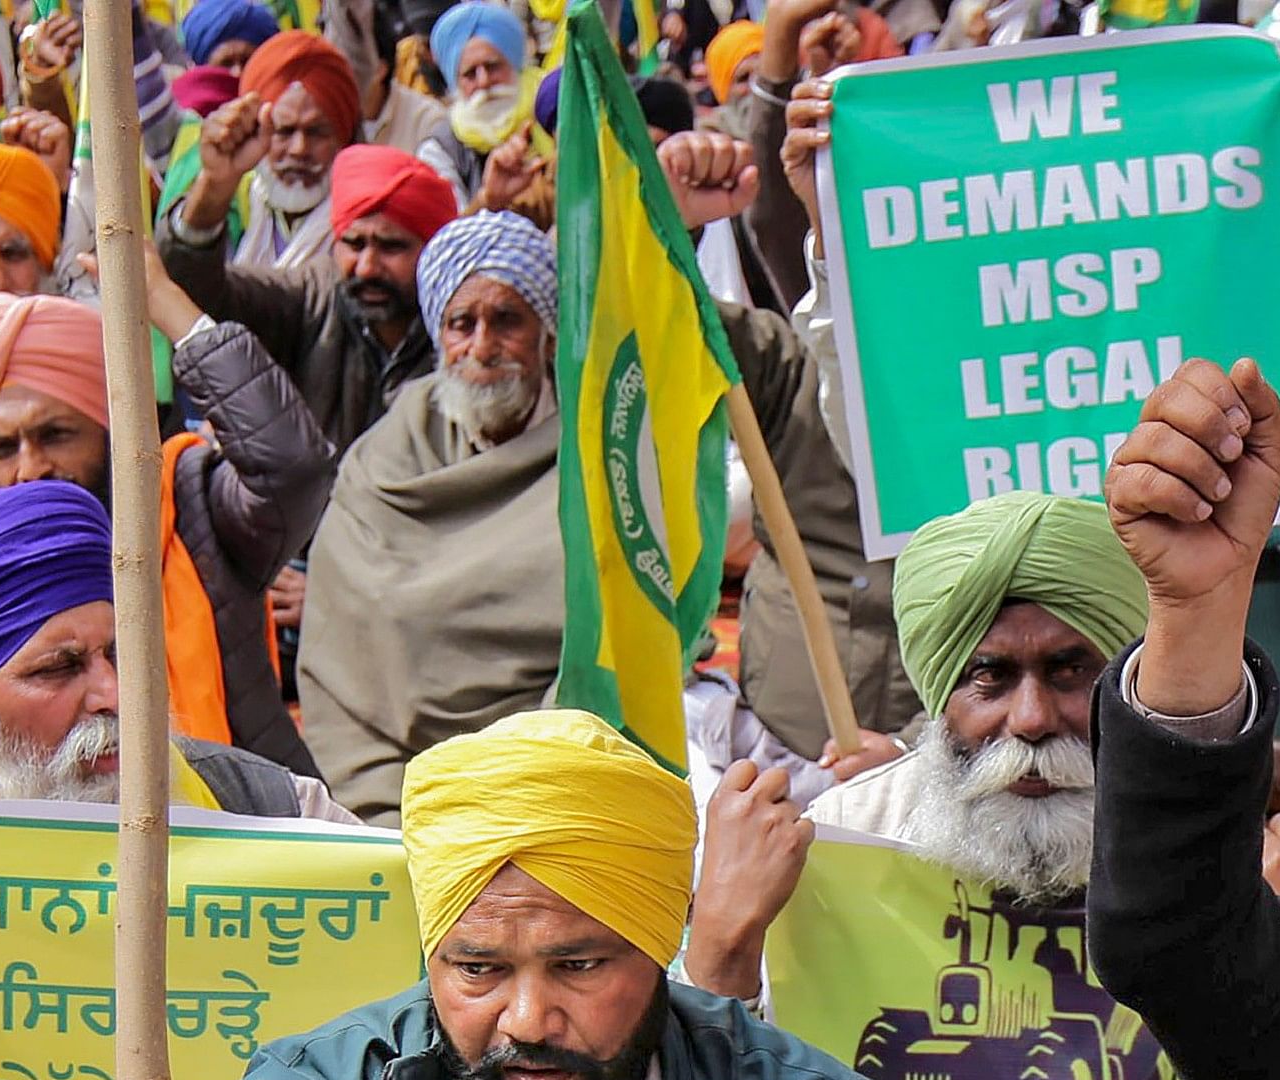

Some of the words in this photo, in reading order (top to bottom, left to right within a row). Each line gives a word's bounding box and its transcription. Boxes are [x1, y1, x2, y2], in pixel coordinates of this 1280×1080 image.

[986, 71, 1122, 143] WE
[862, 146, 1264, 249] DEMANDS
[978, 248, 1162, 328] MSP
[962, 431, 1128, 502] RIG
